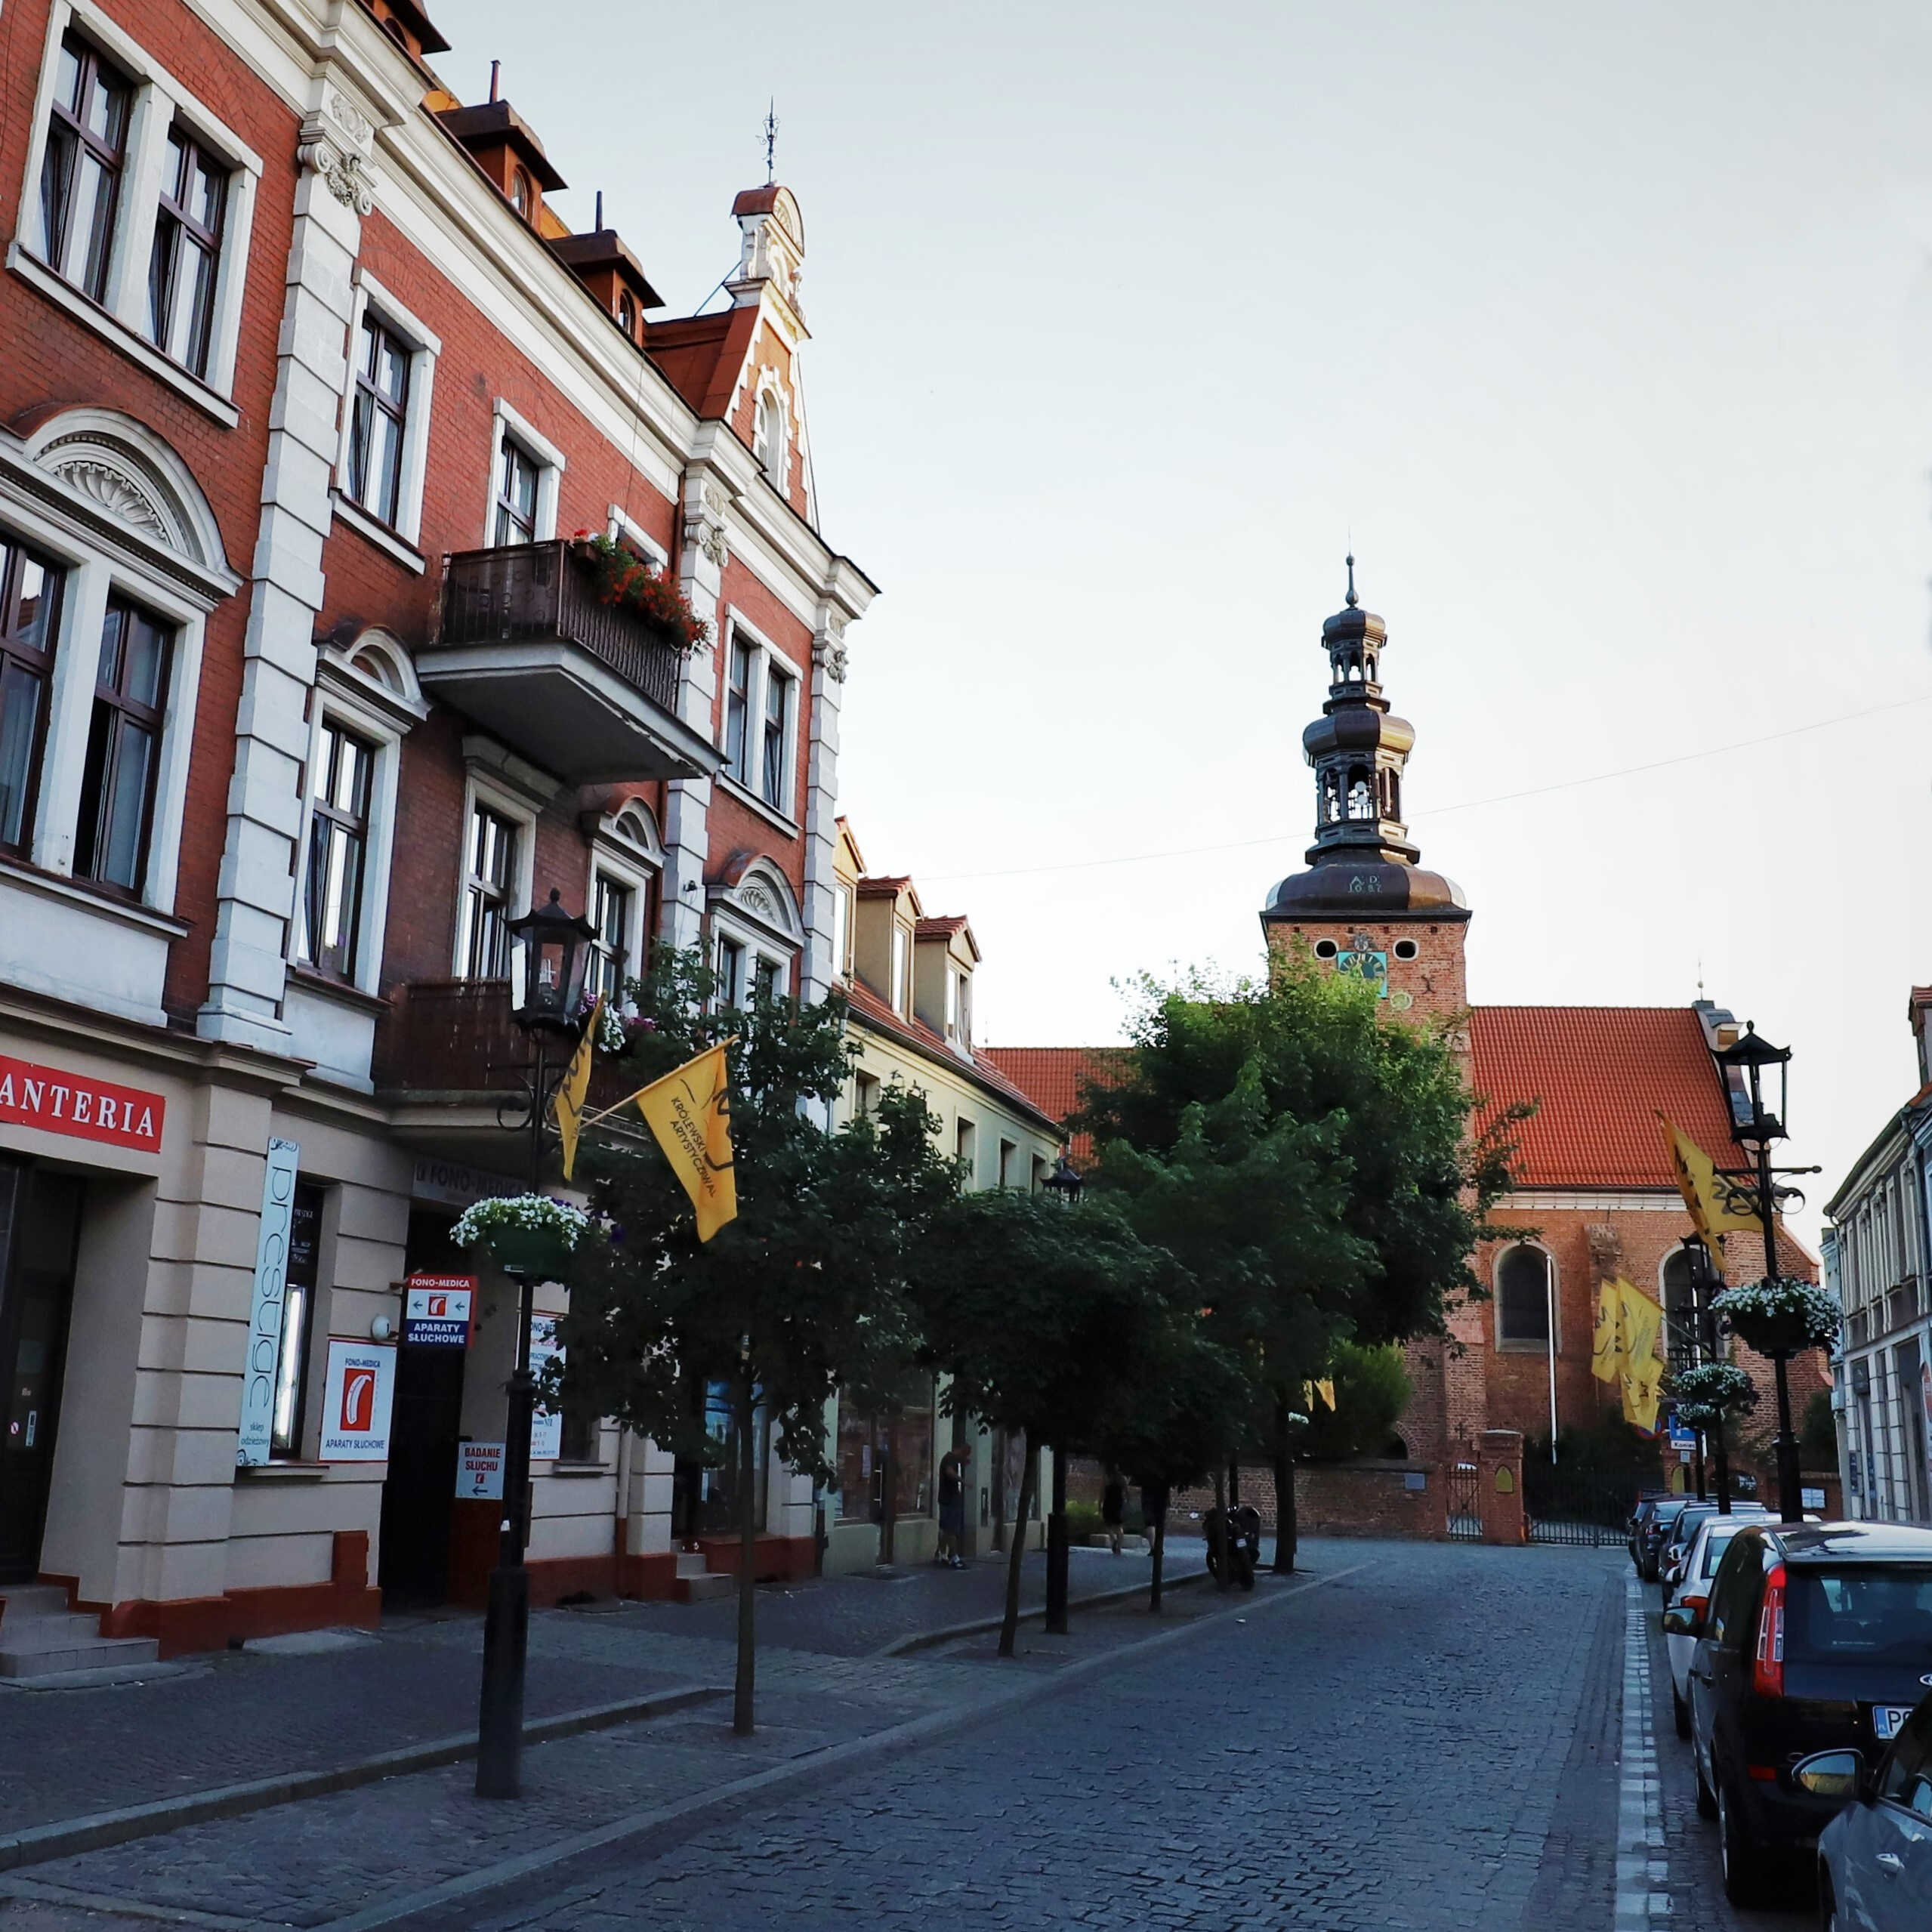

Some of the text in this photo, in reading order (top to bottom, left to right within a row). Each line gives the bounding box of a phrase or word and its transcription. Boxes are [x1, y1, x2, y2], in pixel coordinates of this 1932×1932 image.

[0, 1072, 155, 1137] ANTERIA
[671, 1097, 707, 1153] KRÓLEWSKI
[249, 1165, 292, 1408] prestige
[411, 1278, 470, 1288] FONO-MEDICA
[414, 1322, 460, 1333] APARATY
[408, 1333, 465, 1344] SŁUCHOWE
[344, 1357, 381, 1368] FONO-MEDICA
[326, 1439, 385, 1449] APARATY SŁUCHOWE
[464, 1447, 501, 1458] BADANIE
[465, 1460, 498, 1471] SŁUCHU
